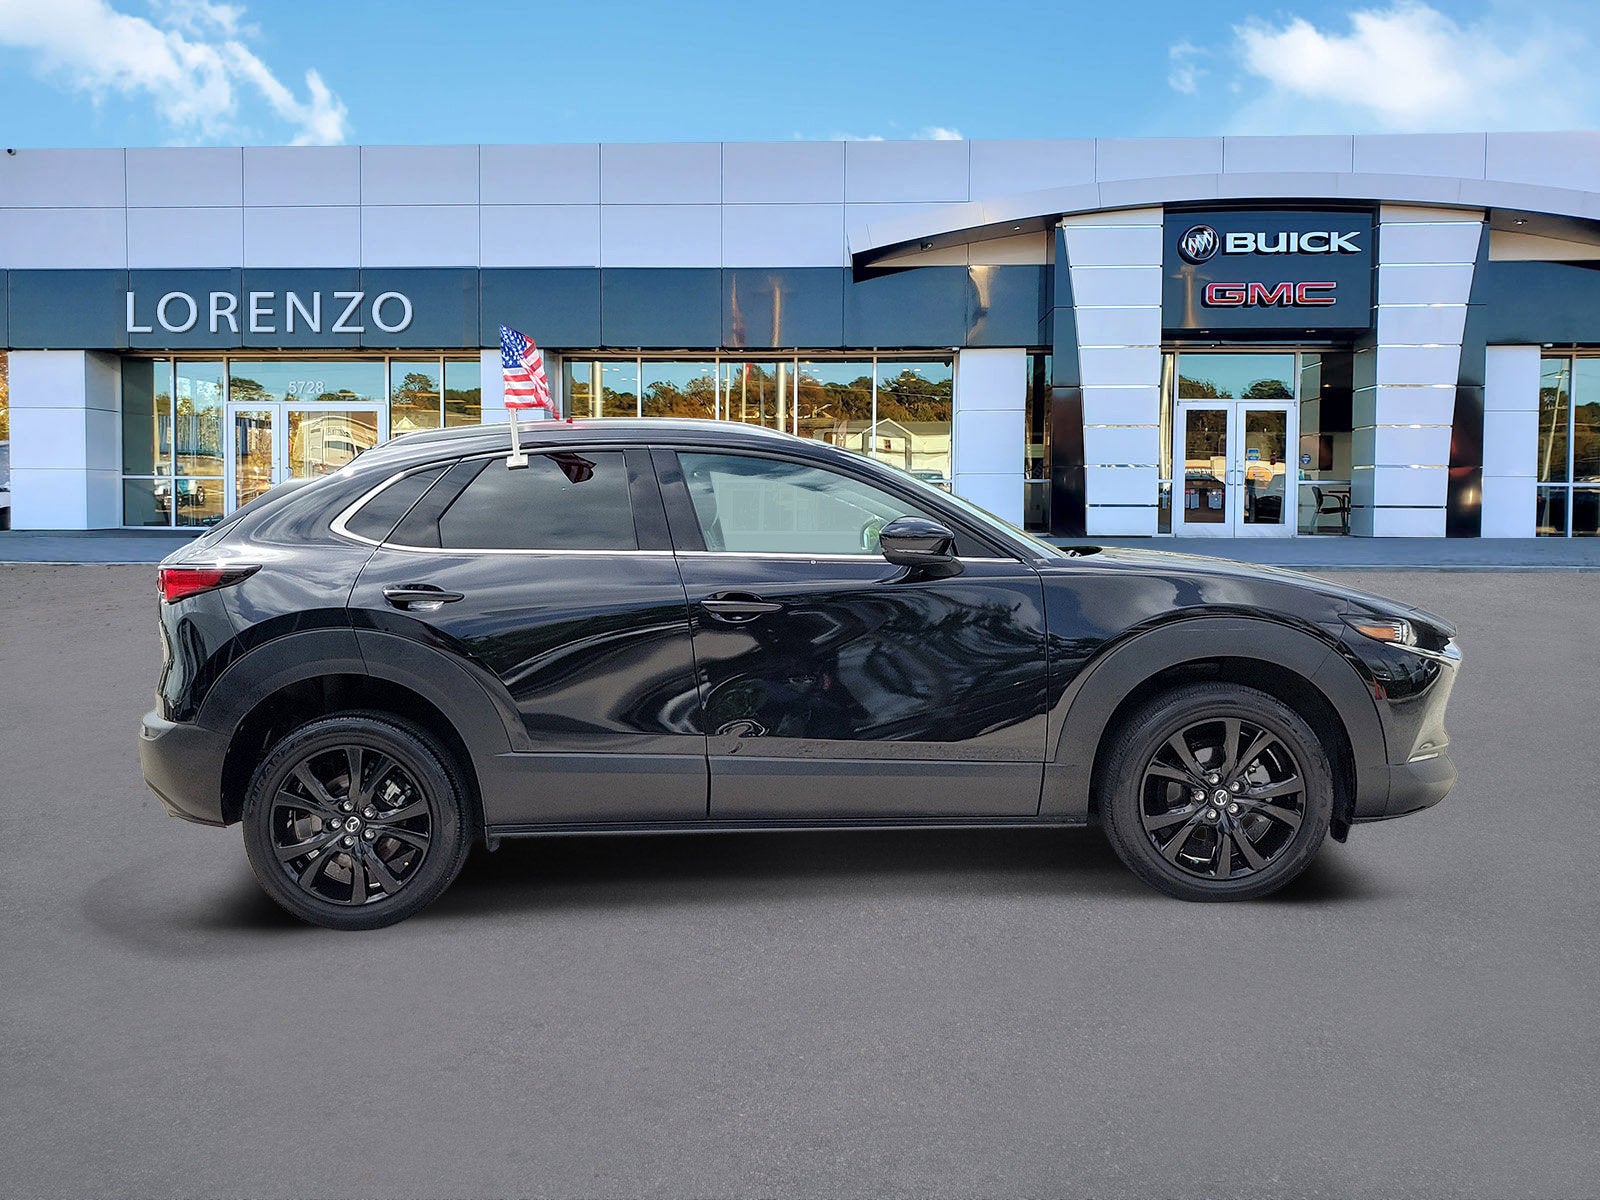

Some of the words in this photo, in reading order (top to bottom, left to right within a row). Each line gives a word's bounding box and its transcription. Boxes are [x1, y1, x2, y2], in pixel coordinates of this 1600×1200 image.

[1225, 231, 1362, 253] BUICK
[1205, 281, 1337, 305] GMC
[126, 291, 414, 334] LORENZO
[288, 380, 325, 395] 5728
